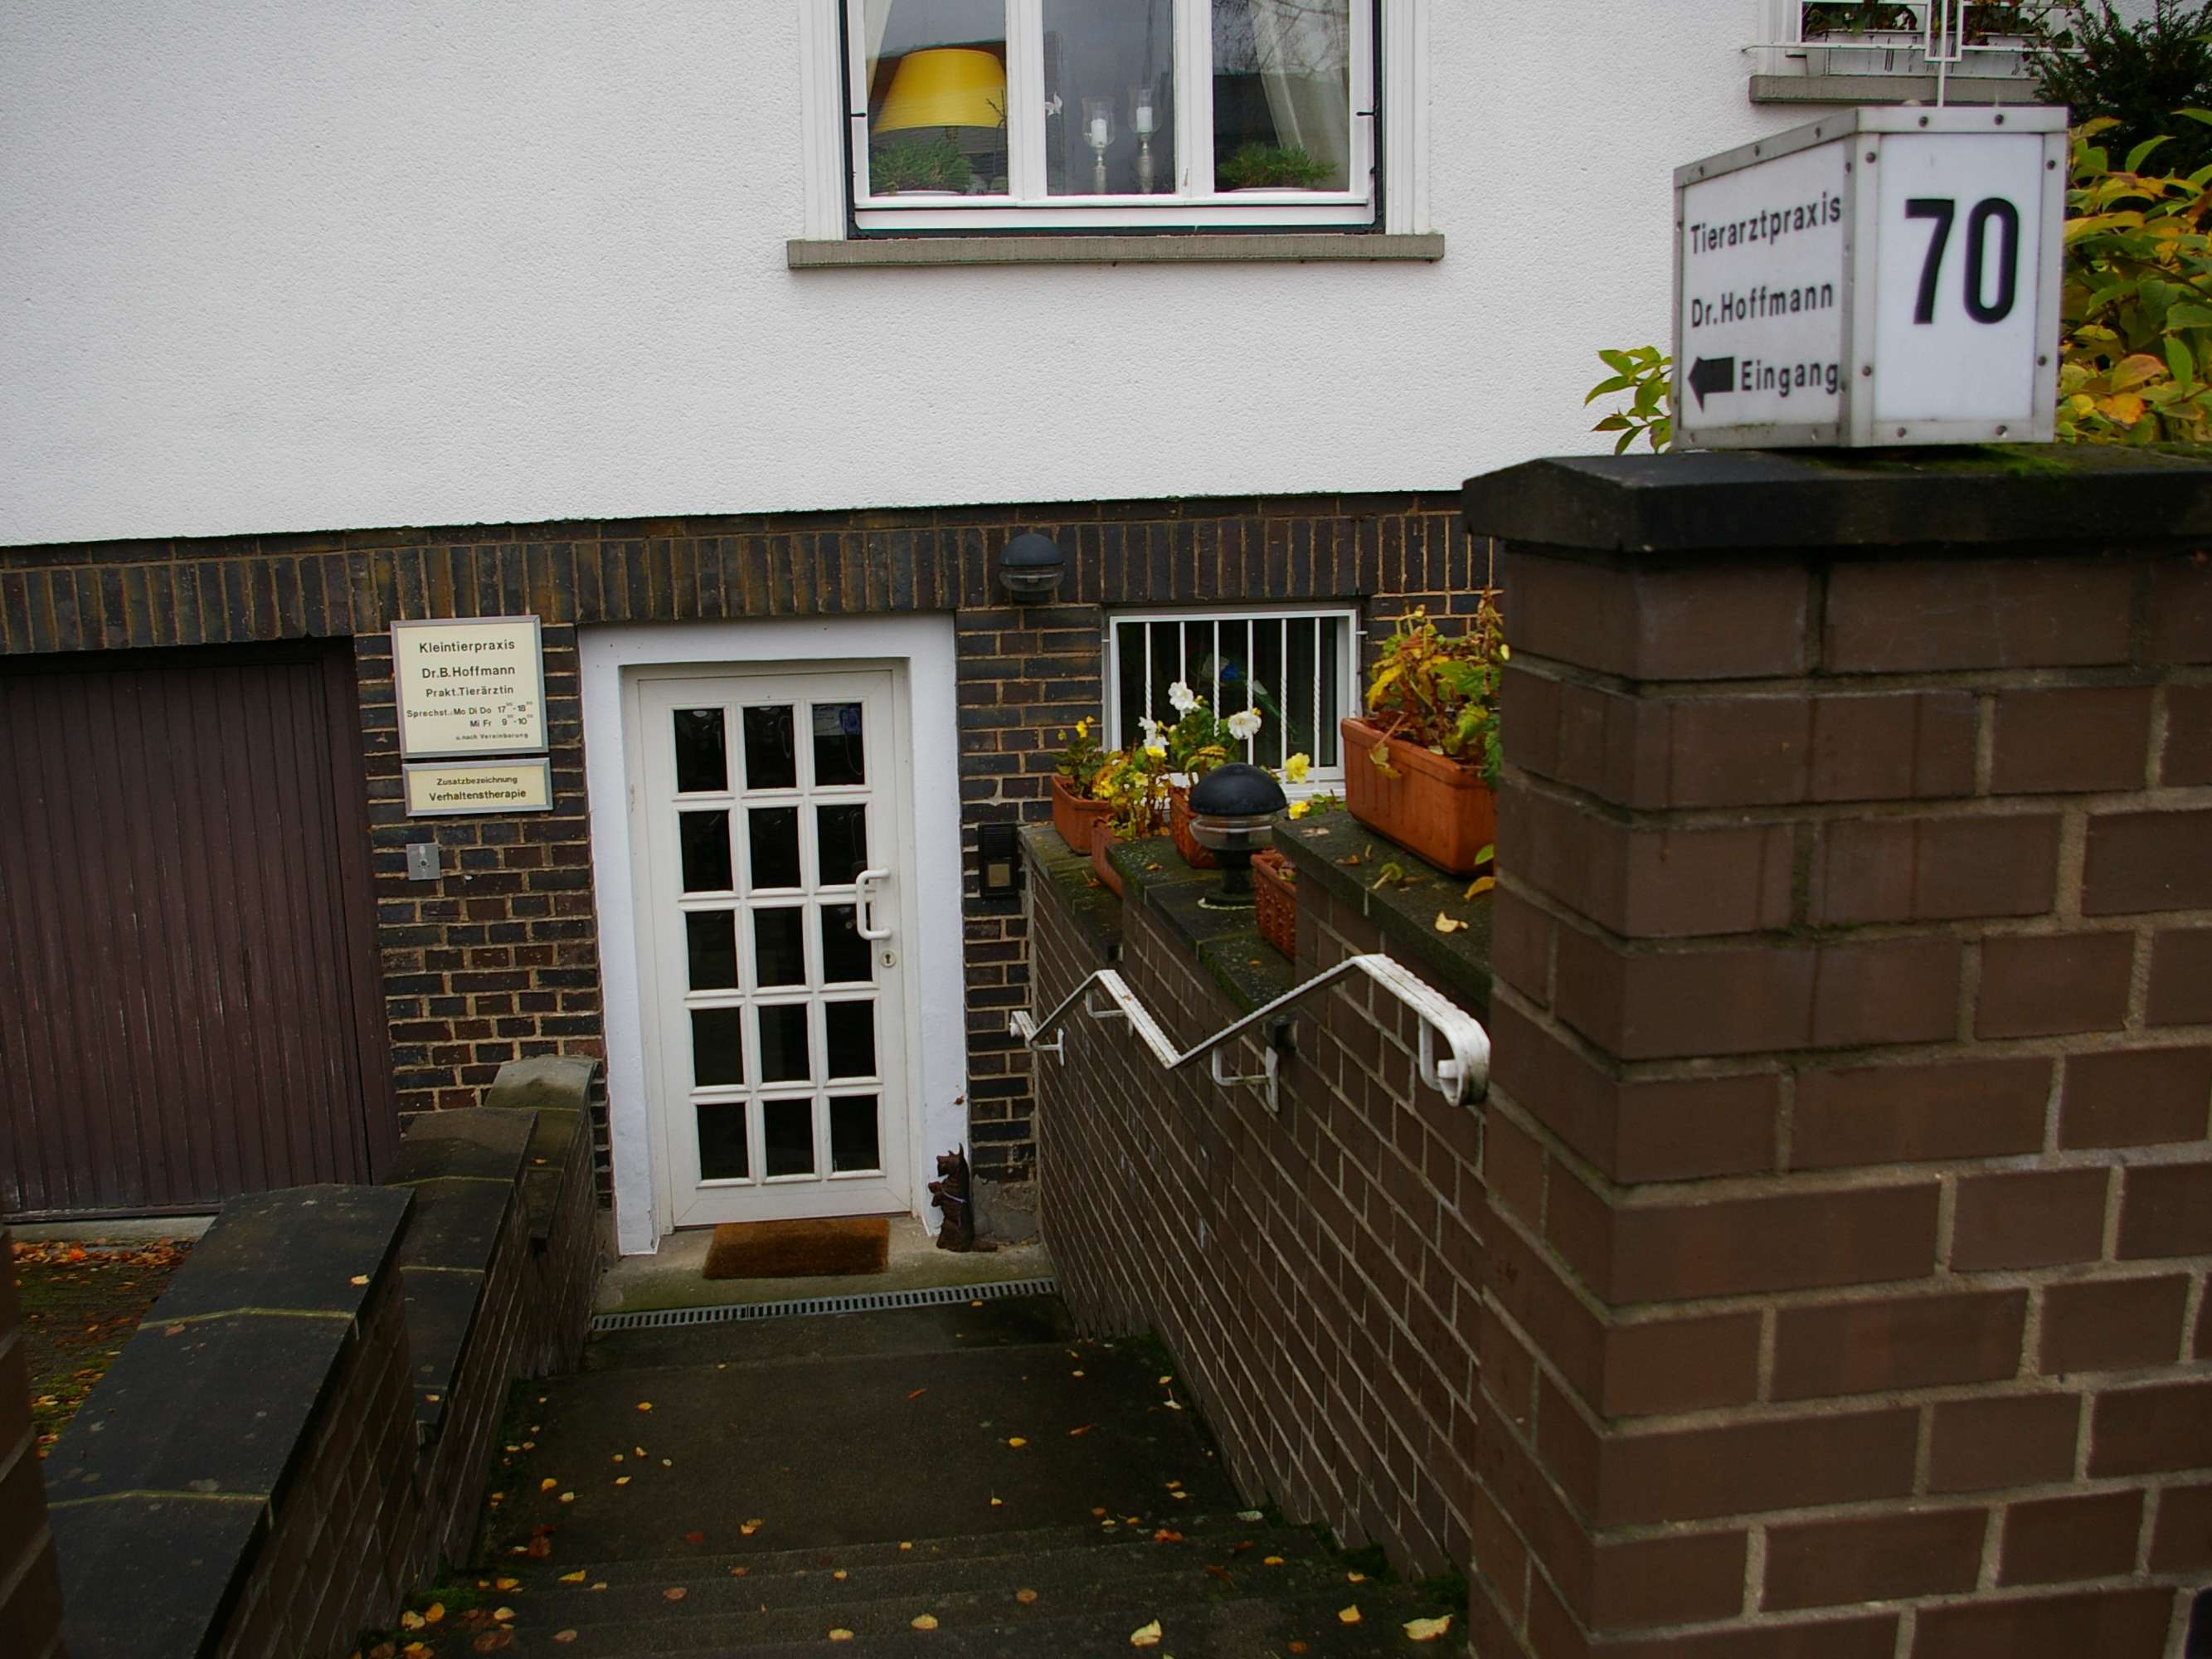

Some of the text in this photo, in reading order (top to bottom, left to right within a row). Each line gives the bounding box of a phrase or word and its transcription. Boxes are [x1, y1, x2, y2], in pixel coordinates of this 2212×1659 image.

[1690, 192, 1841, 254] Tierarztpraxis
[1905, 197, 2019, 324] 70
[1741, 360, 1839, 397] Eingang
[419, 640, 515, 653] Kleintierpraxis
[479, 706, 492, 714] Do
[436, 776, 518, 786] Zusatzbezeichnung
[429, 789, 527, 801] Verhaltenstherapie
